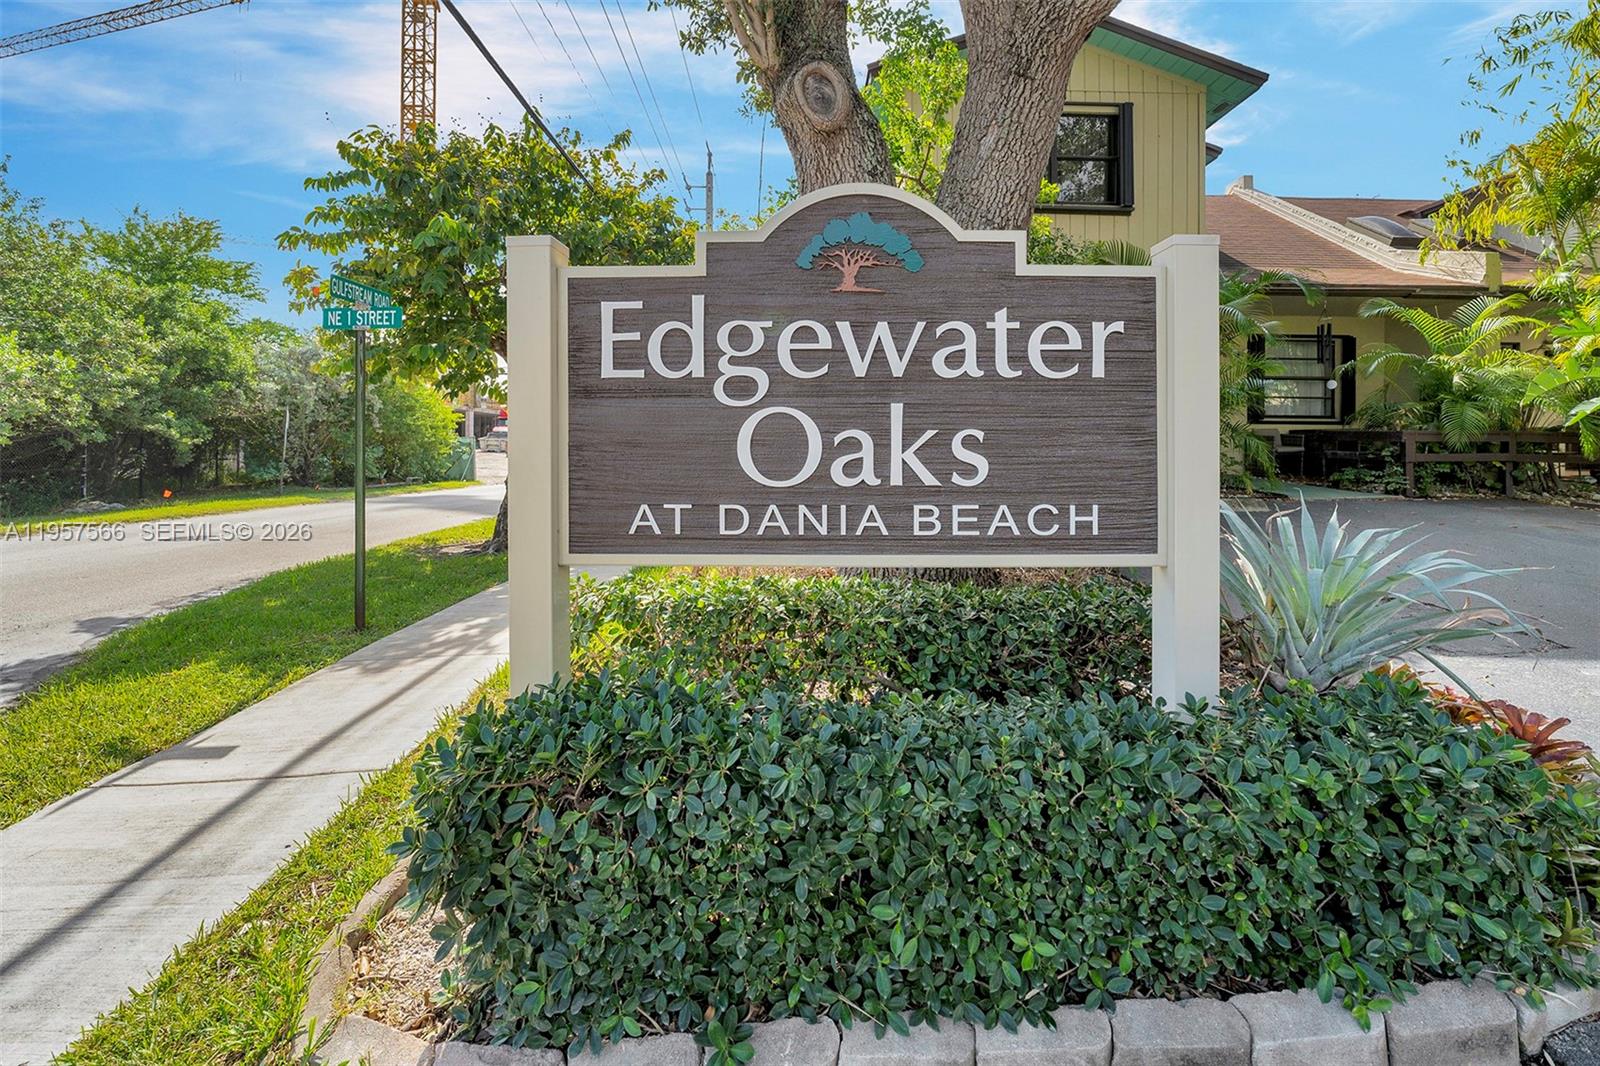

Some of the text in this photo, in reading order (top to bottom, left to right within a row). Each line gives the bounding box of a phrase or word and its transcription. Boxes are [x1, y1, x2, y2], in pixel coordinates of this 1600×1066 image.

[374, 293, 390, 307] ROAD
[328, 310, 396, 325] NE 1 STREET
[600, 294, 1125, 407] Edgewater
[736, 402, 991, 488] Oaks
[628, 503, 1101, 537] AT DANIA BEACH
